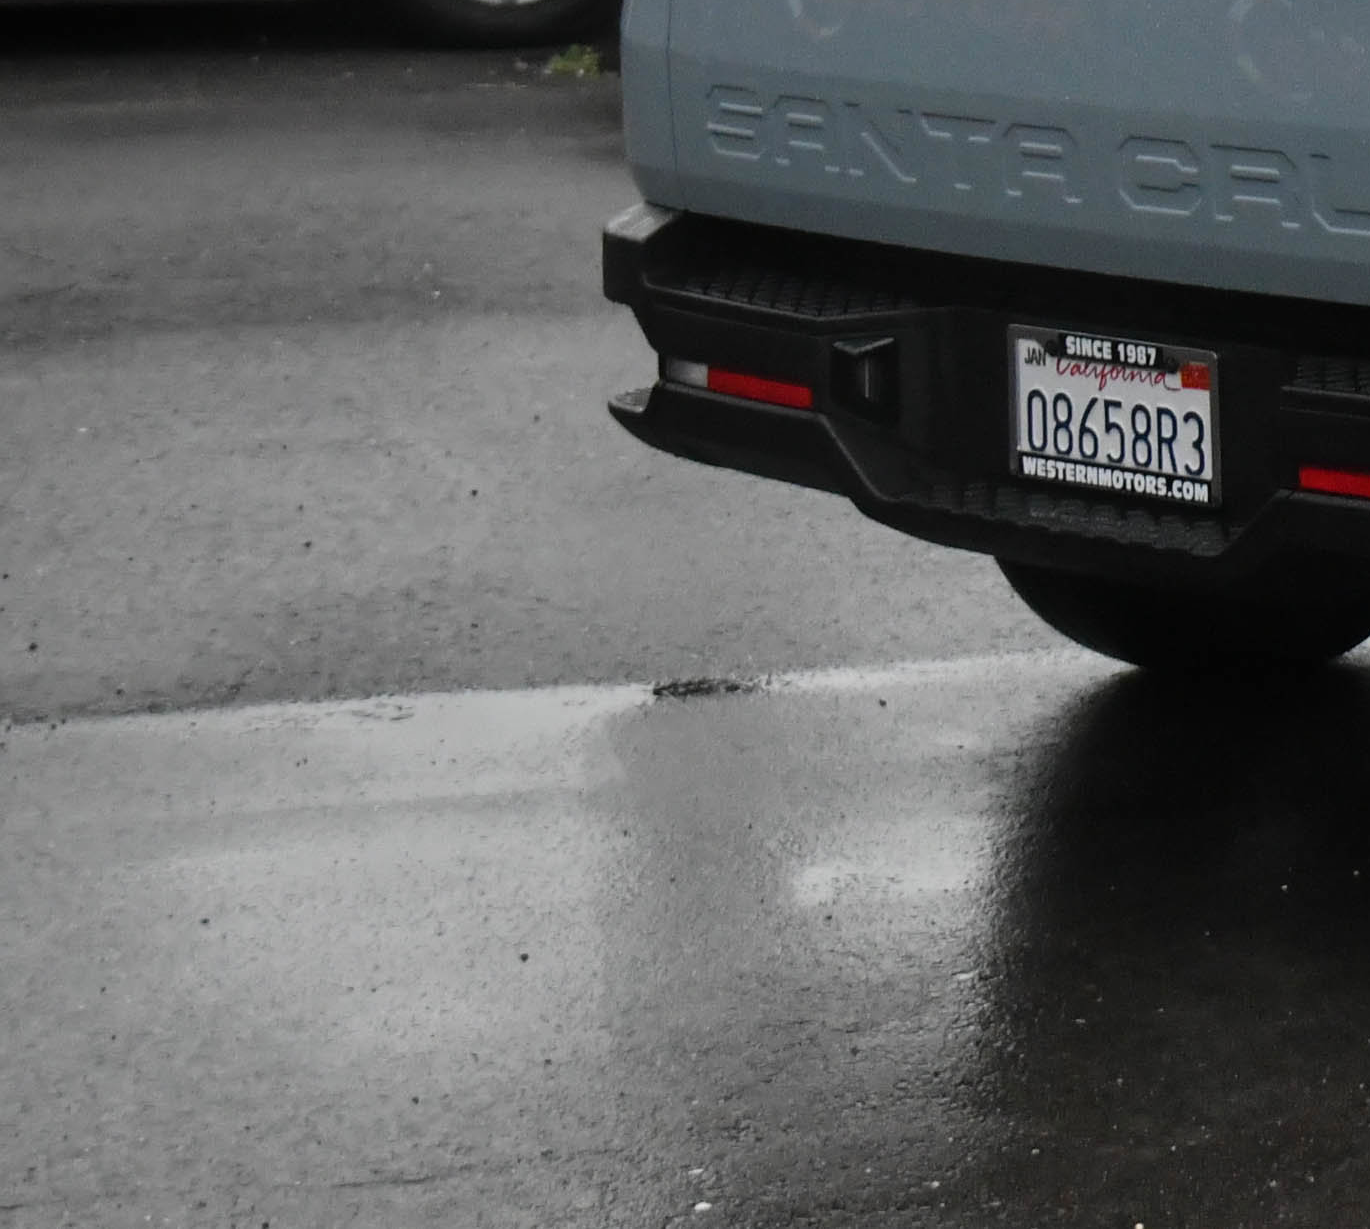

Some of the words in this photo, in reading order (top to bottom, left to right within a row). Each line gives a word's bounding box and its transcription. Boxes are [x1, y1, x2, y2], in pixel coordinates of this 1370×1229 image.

[705, 84, 1082, 205] SANTA
[1065, 335, 1113, 361] SINCE
[1117, 343, 1157, 366] 1987
[1027, 389, 1205, 477] 08658R3
[1022, 455, 1210, 503] WESTERNMOTORS.COM
